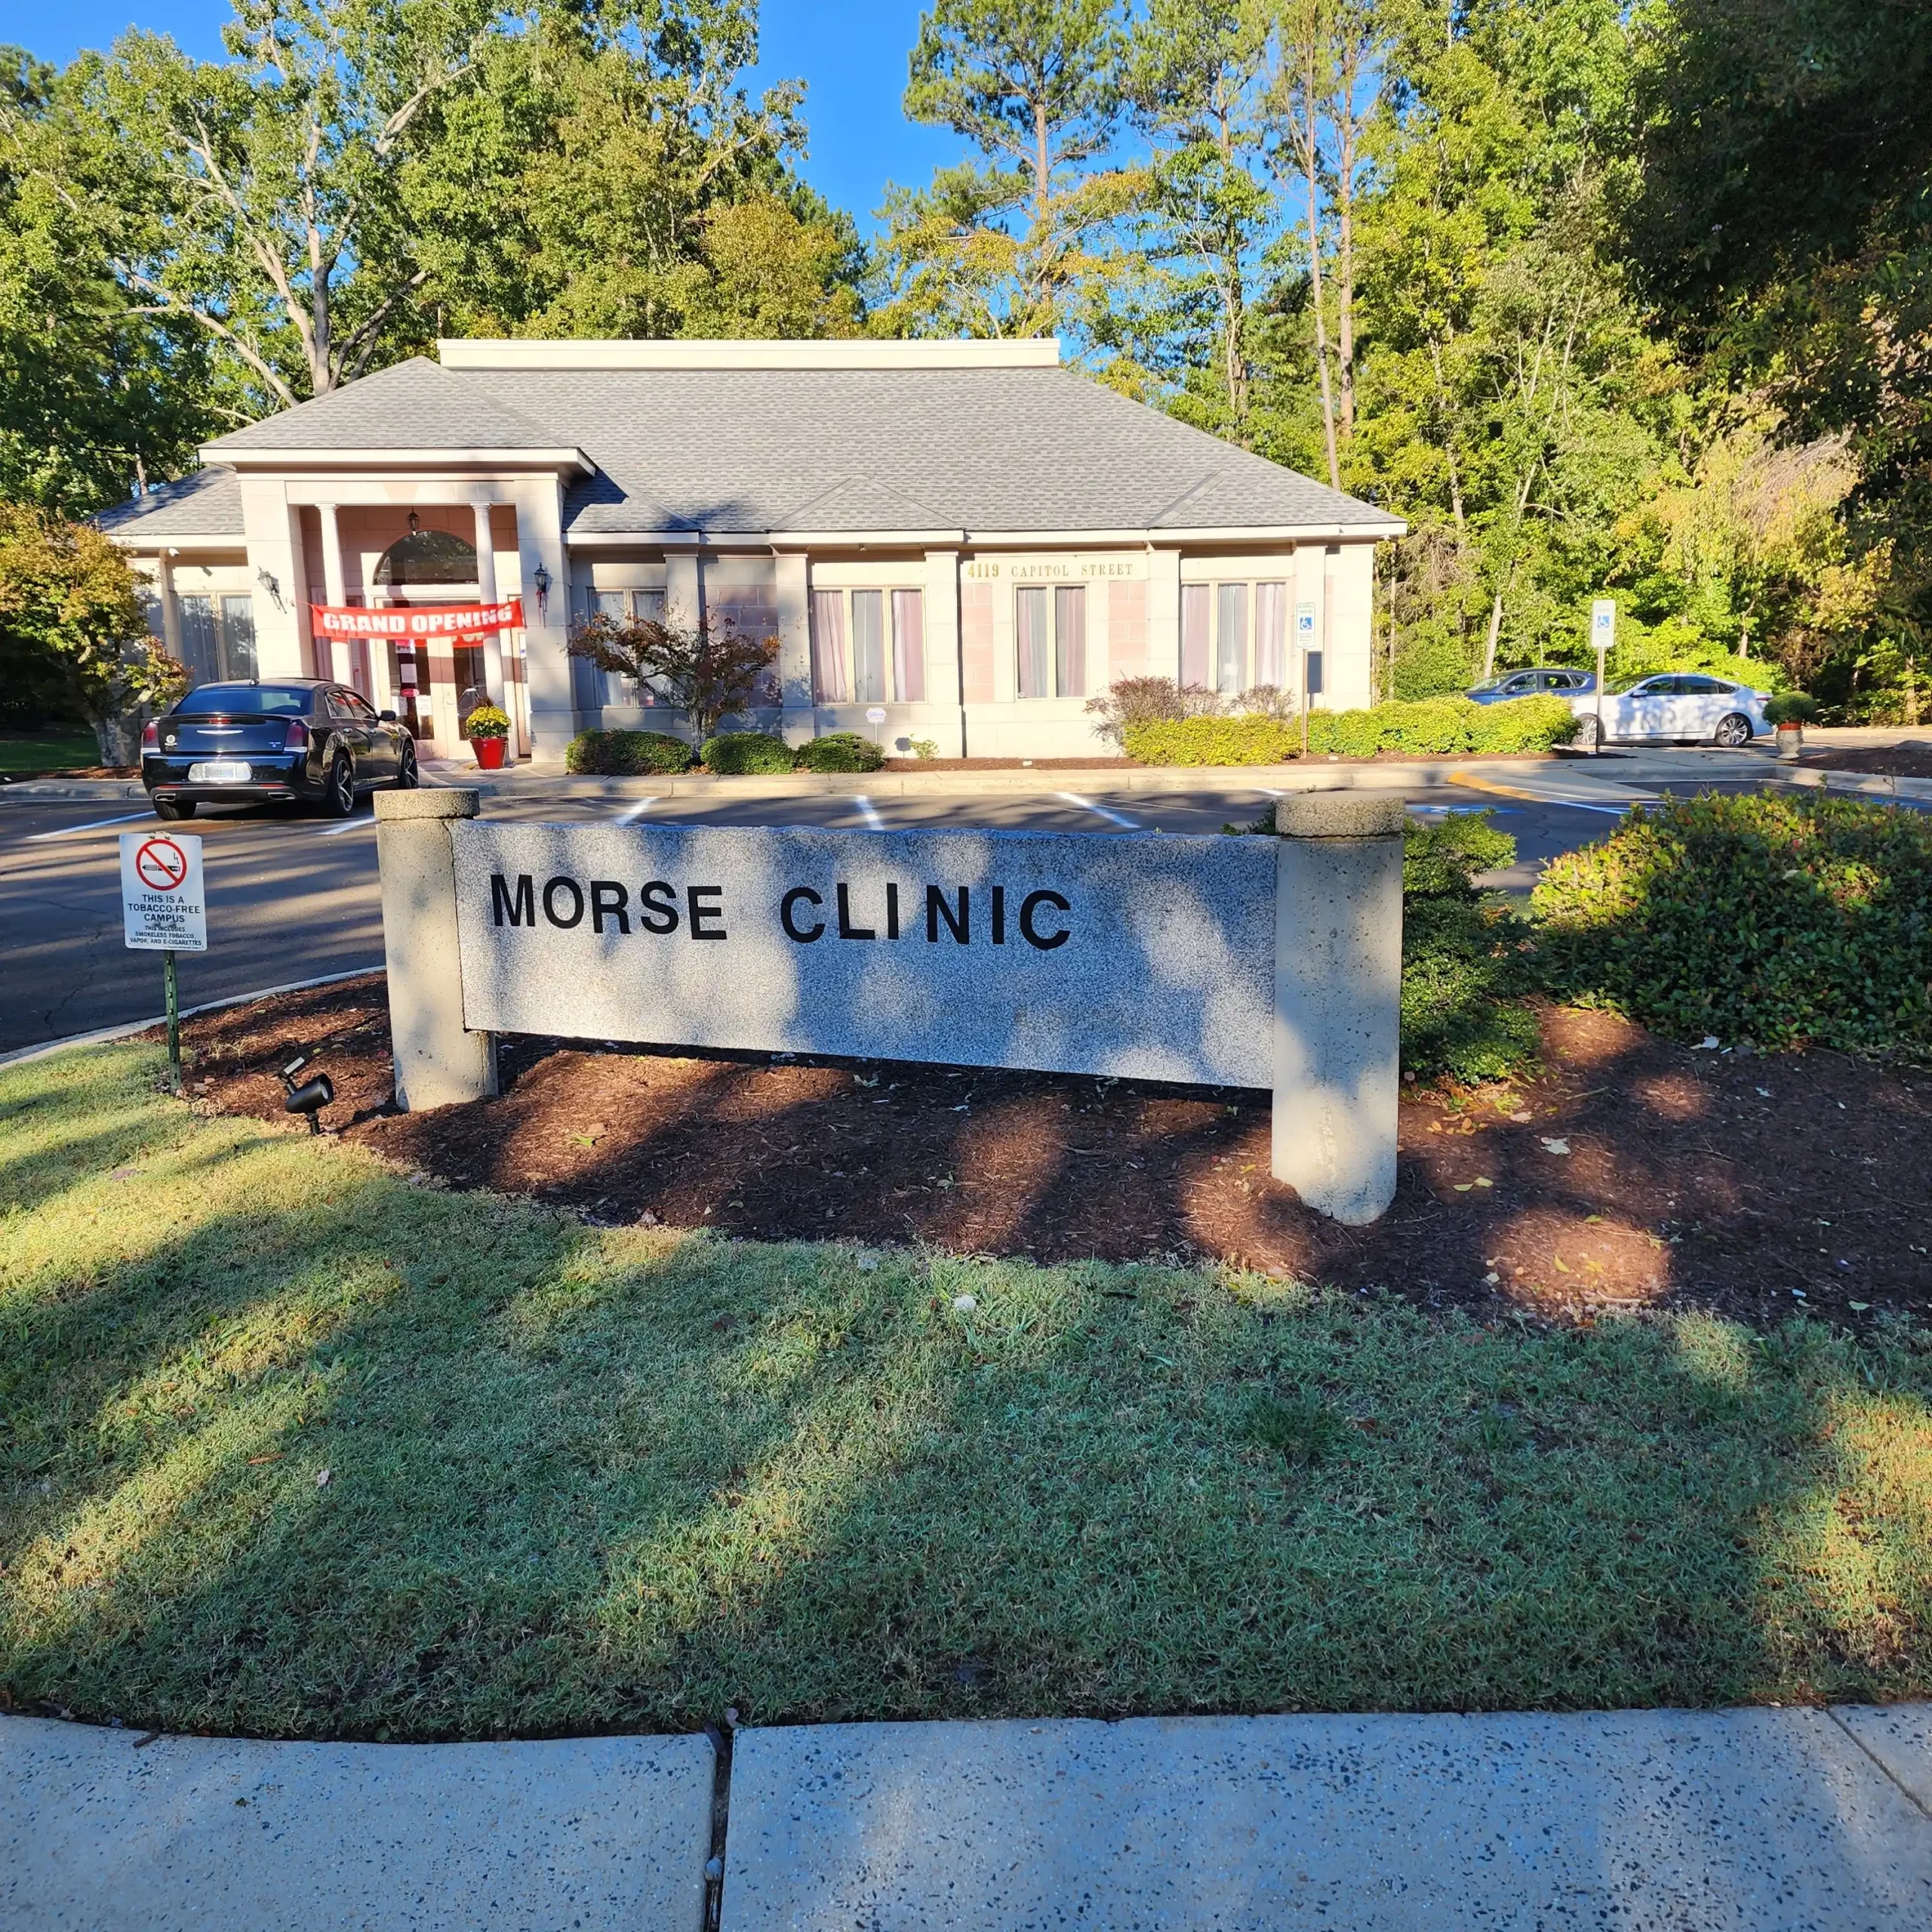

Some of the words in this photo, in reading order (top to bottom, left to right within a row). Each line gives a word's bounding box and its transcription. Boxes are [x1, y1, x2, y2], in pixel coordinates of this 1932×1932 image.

[968, 563, 999, 578] 4119
[1011, 565, 1069, 577] CAPITOL
[1081, 564, 1134, 576] STREET
[323, 612, 406, 632] GRAND
[411, 605, 513, 632] OPENING
[142, 894, 163, 903] THIS
[128, 903, 201, 914] TOBACCO-FREE
[491, 874, 727, 940] MORSE
[780, 883, 1072, 949] CLINIC
[144, 914, 185, 922] CAMPUS
